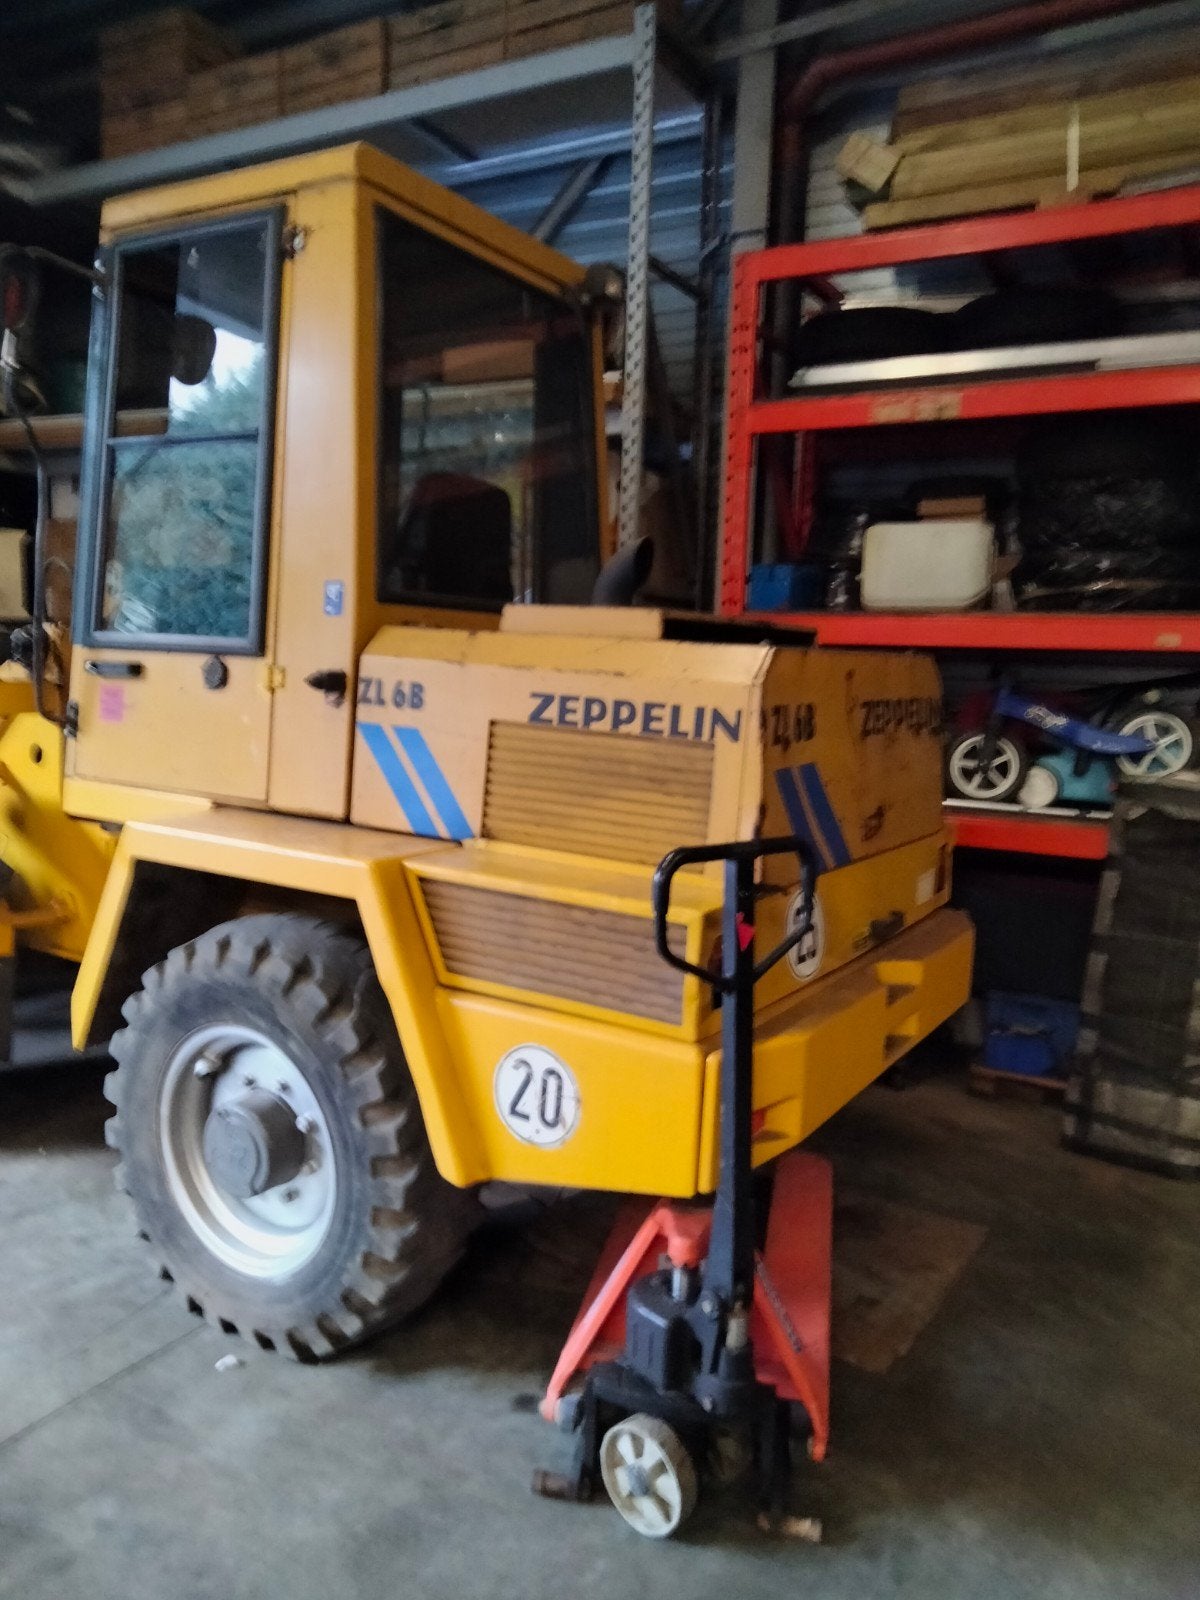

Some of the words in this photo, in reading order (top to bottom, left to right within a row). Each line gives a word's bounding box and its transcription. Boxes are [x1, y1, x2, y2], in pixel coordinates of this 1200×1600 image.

[357, 677, 385, 705] ZL
[392, 679, 425, 709] 6B
[528, 691, 743, 743] ZEPPELIN
[509, 1058, 563, 1129] 20
